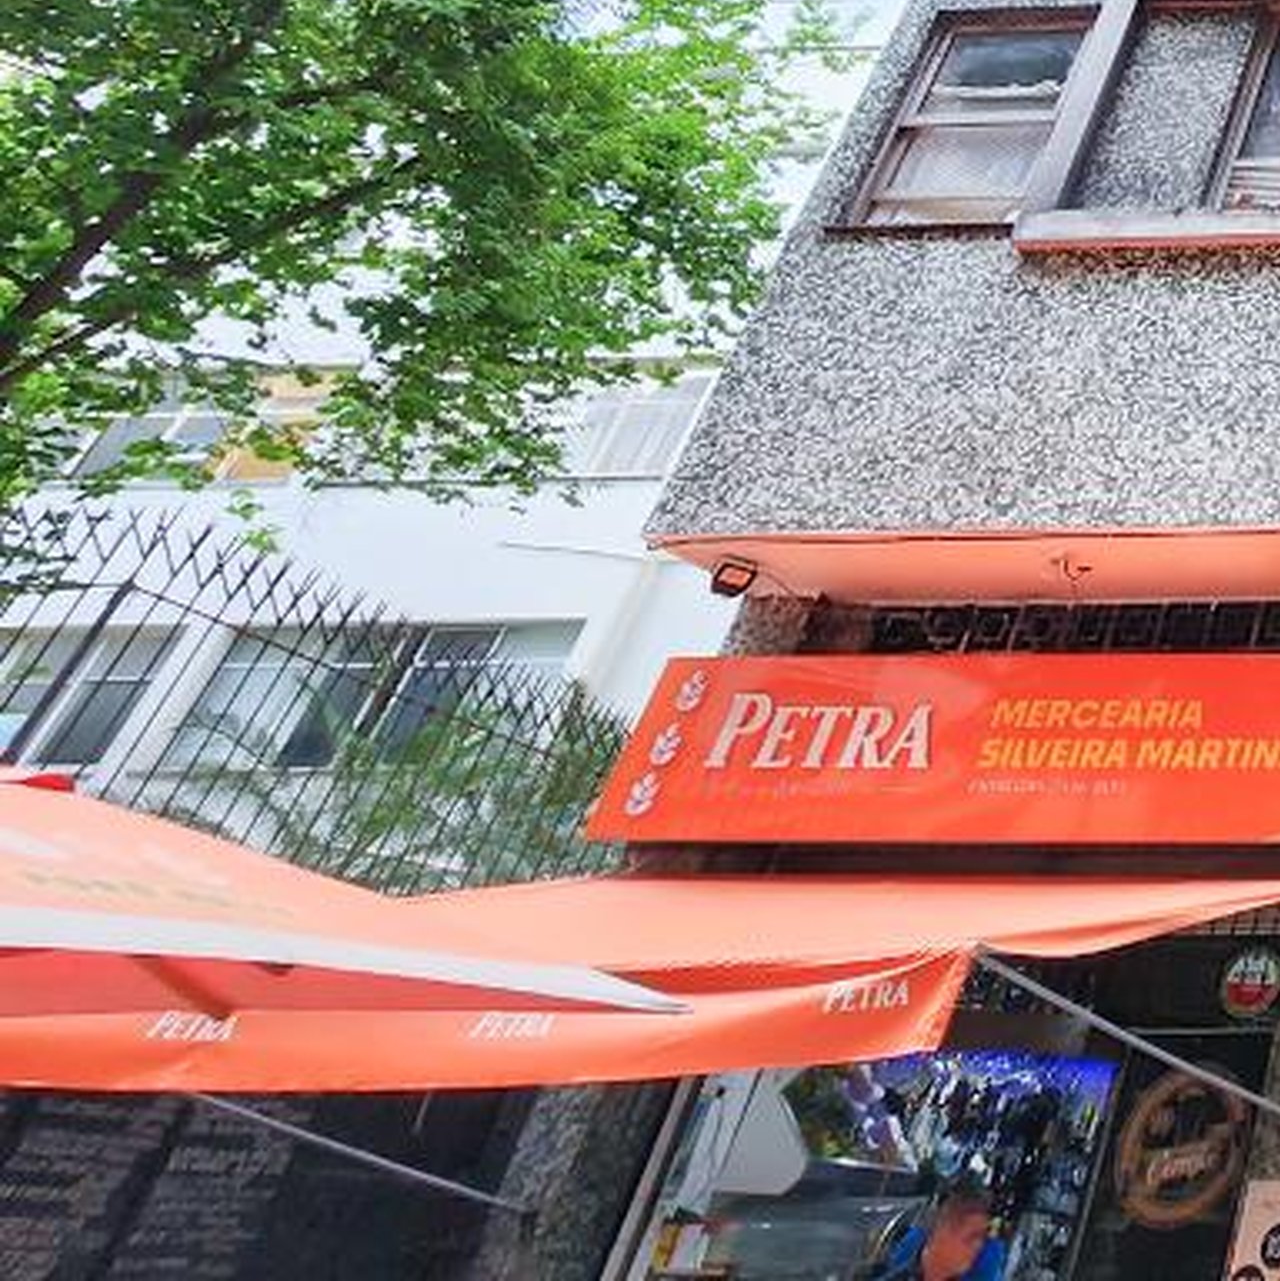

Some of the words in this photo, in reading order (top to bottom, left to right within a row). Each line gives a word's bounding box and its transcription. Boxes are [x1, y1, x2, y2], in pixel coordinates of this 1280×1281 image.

[990, 698, 1203, 729] MERCEARIA
[703, 692, 934, 770] PETRA
[978, 738, 1129, 770] SILVEIRA
[822, 979, 910, 1014] PETRA
[146, 1009, 239, 1042] PETRA
[469, 1011, 556, 1039] PETRA
